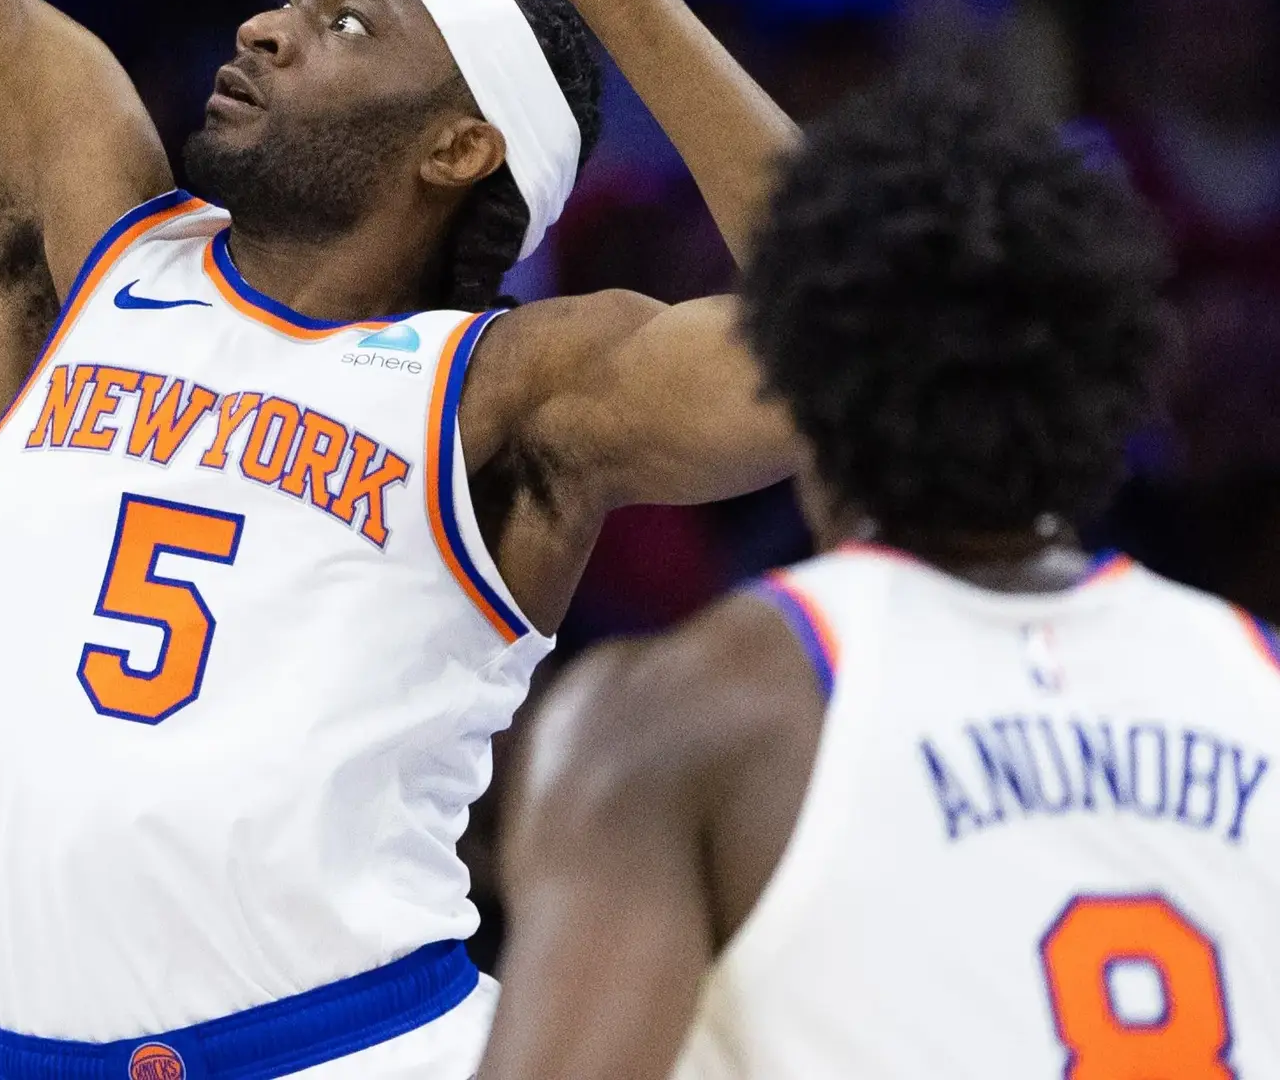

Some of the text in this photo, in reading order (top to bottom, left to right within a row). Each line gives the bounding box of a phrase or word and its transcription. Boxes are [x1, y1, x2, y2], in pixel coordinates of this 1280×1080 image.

[23, 362, 412, 551] NEW YORK
[340, 352, 422, 375] sphere
[76, 491, 246, 726] 5
[920, 716, 1269, 840] ANUNOBY
[1037, 892, 1240, 1080] 8
